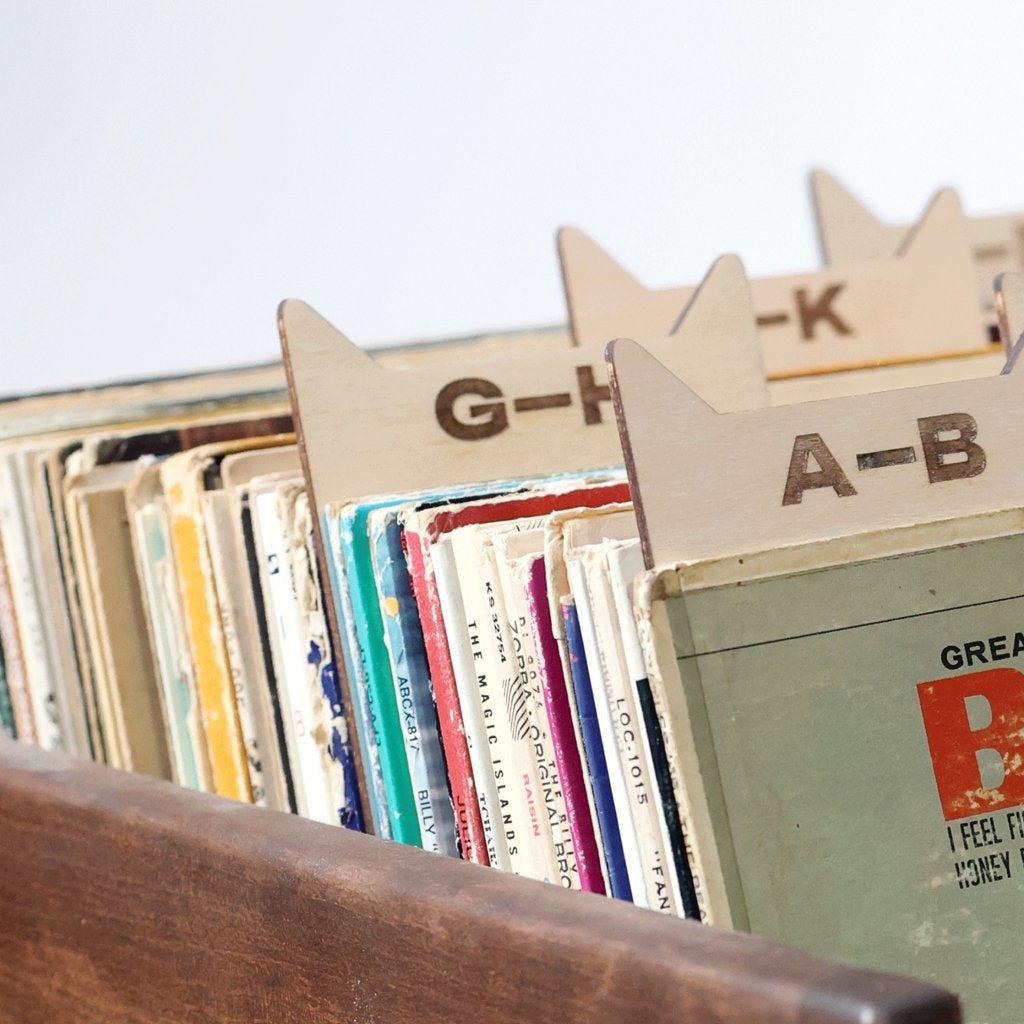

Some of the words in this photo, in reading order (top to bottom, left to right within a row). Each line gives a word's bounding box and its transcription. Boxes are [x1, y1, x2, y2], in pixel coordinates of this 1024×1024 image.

[756, 280, 854, 340] -K
[782, 413, 987, 506] A-B
[485, 582, 495, 608] KS
[468, 620, 483, 661] THE
[477, 674, 498, 746] MAGIC
[492, 759, 518, 856] ISLANDS
[509, 620, 532, 700] ZORBA
[530, 725, 559, 827] ORIGINAL
[617, 698, 649, 804] LOC-1015
[398, 676, 420, 751] ABCX-817
[418, 789, 436, 835] BILLY
[549, 761, 562, 797] THE
[523, 774, 541, 837] RAISIN
[947, 827, 956, 853] I
[960, 817, 1003, 850] FEEL
[955, 851, 1012, 890] HONEY
